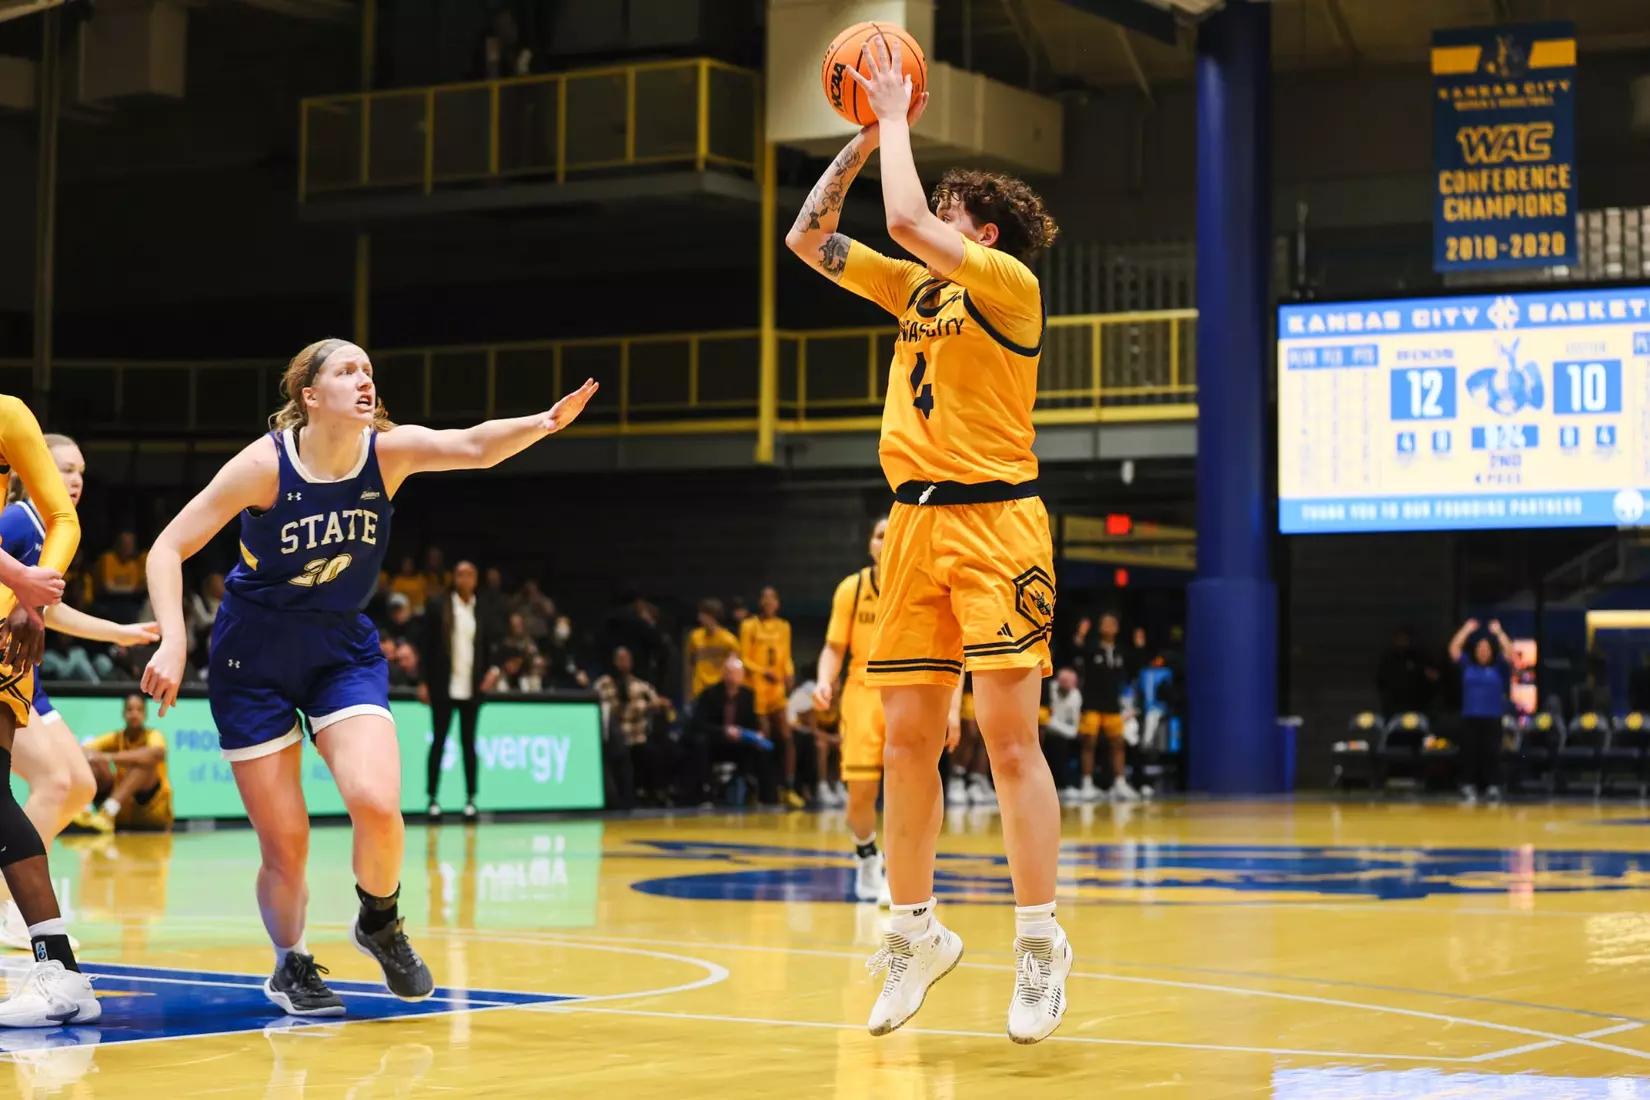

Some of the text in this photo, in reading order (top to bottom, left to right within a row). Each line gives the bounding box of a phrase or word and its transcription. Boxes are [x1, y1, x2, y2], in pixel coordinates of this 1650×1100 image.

[1456, 121, 1554, 164] WAC
[1439, 164, 1571, 195] CONFERENCE
[1443, 191, 1567, 222] CHAMPIONS
[1287, 311, 1401, 334] KANSAS
[1411, 306, 1479, 328] CITY
[910, 352, 934, 420] 4
[1407, 369, 1443, 417] 12
[1567, 363, 1607, 412] 10
[281, 508, 379, 554] STATE
[288, 553, 353, 588] 20
